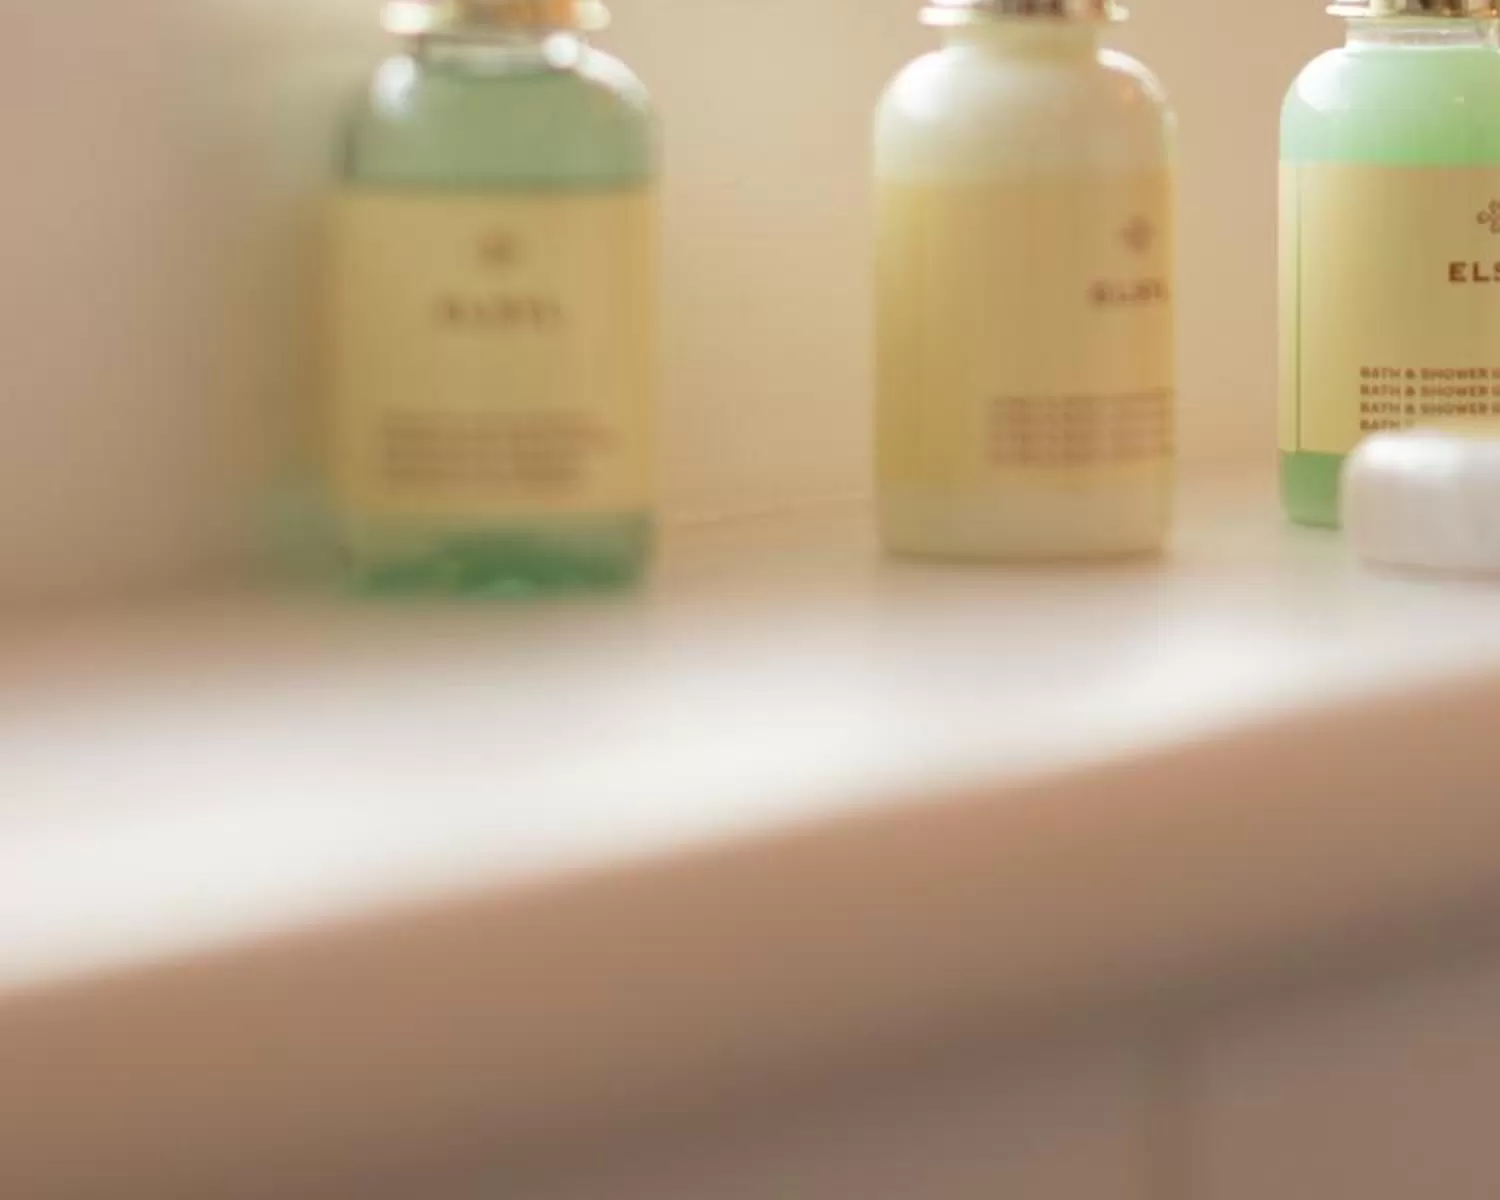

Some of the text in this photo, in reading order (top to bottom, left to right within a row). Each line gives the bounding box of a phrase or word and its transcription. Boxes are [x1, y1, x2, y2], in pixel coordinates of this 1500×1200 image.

[1360, 366, 1401, 379] BATH
[1420, 367, 1489, 380] SHOWER
[1360, 384, 1401, 397] BATH
[1420, 384, 1489, 397] SHOWER
[1360, 401, 1401, 414] BATH
[1420, 402, 1489, 415] SHOWER
[1360, 419, 1401, 431] BATH
